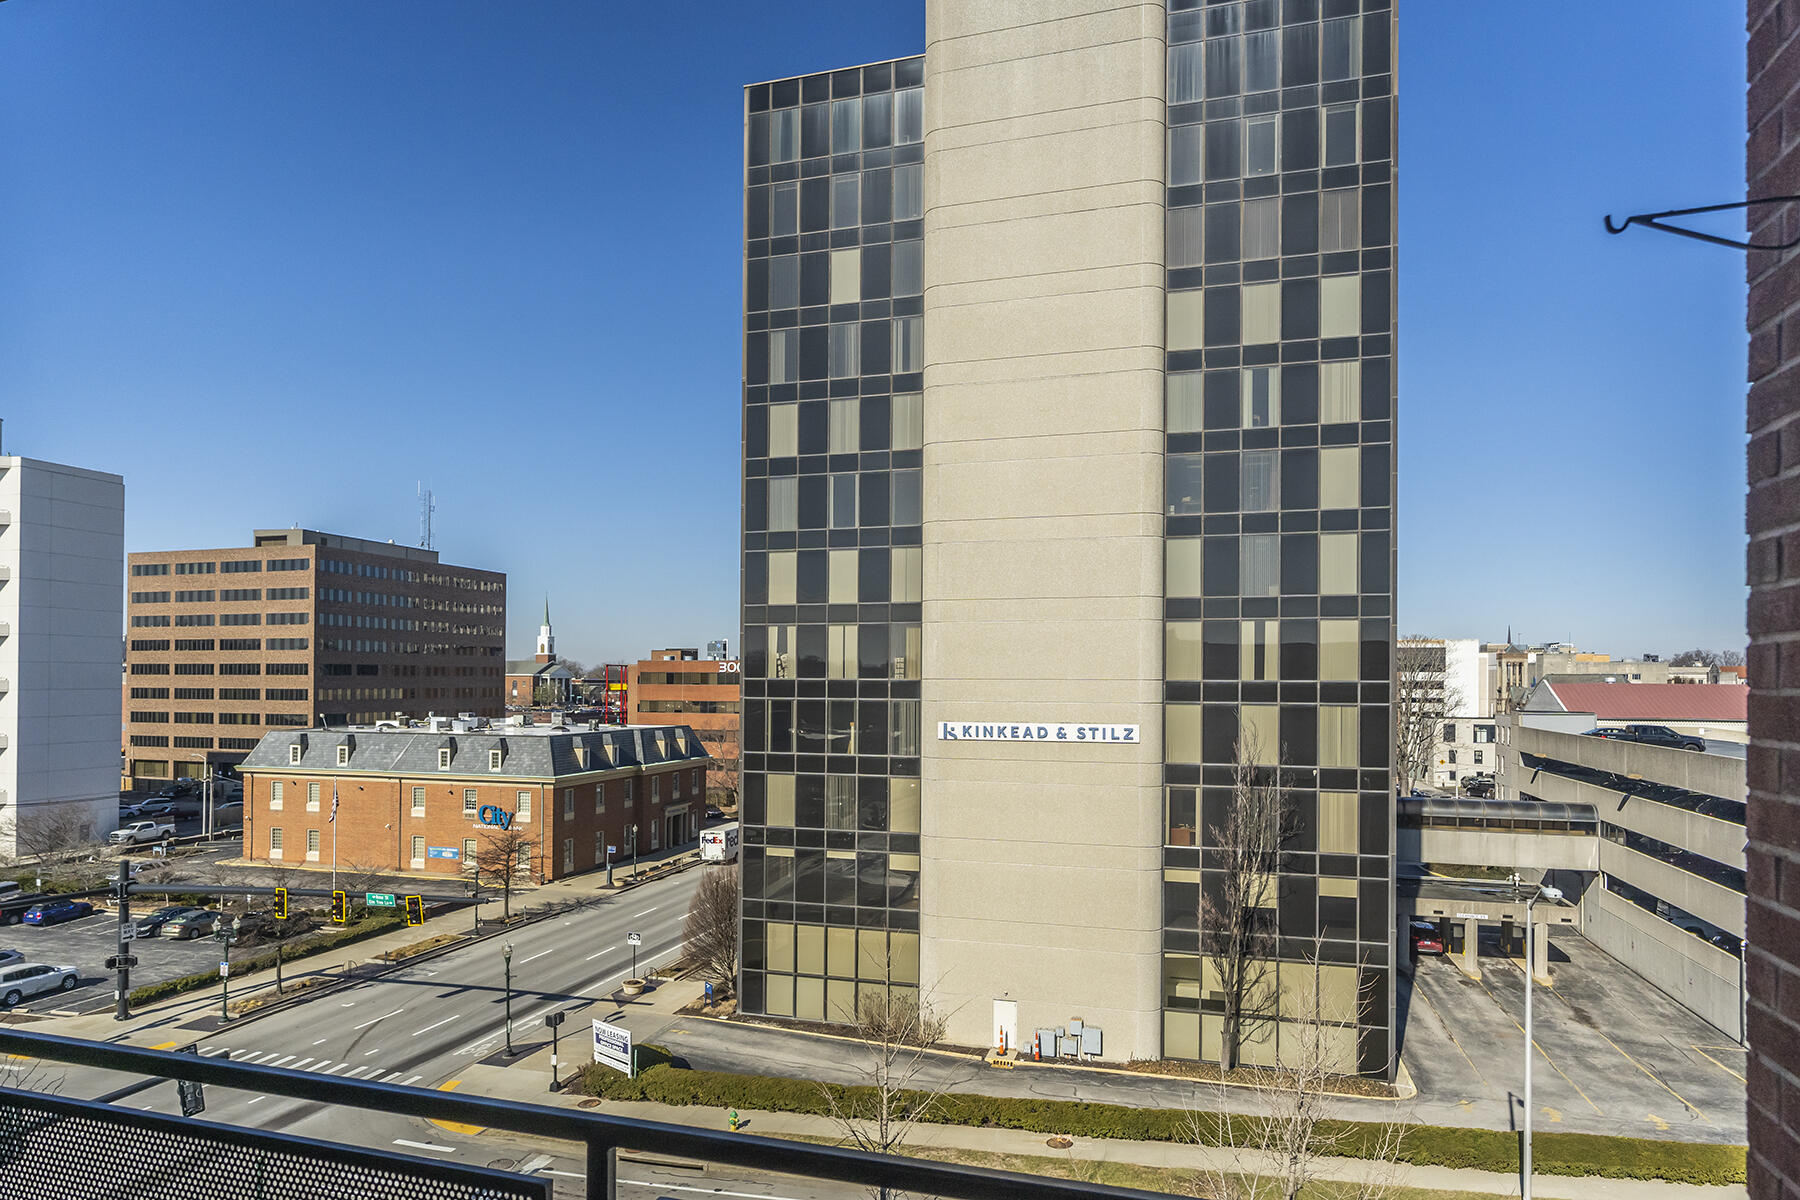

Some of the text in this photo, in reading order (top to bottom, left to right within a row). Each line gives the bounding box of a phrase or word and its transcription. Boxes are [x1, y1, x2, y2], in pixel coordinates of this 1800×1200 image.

[962, 725, 1049, 739] KINKEAD
[1056, 726, 1067, 740] &
[1076, 727, 1134, 741] STILZ
[478, 804, 514, 831] City
[701, 836, 723, 845] FedEx
[595, 1025, 606, 1036] NOW
[607, 1029, 629, 1043] LEASING
